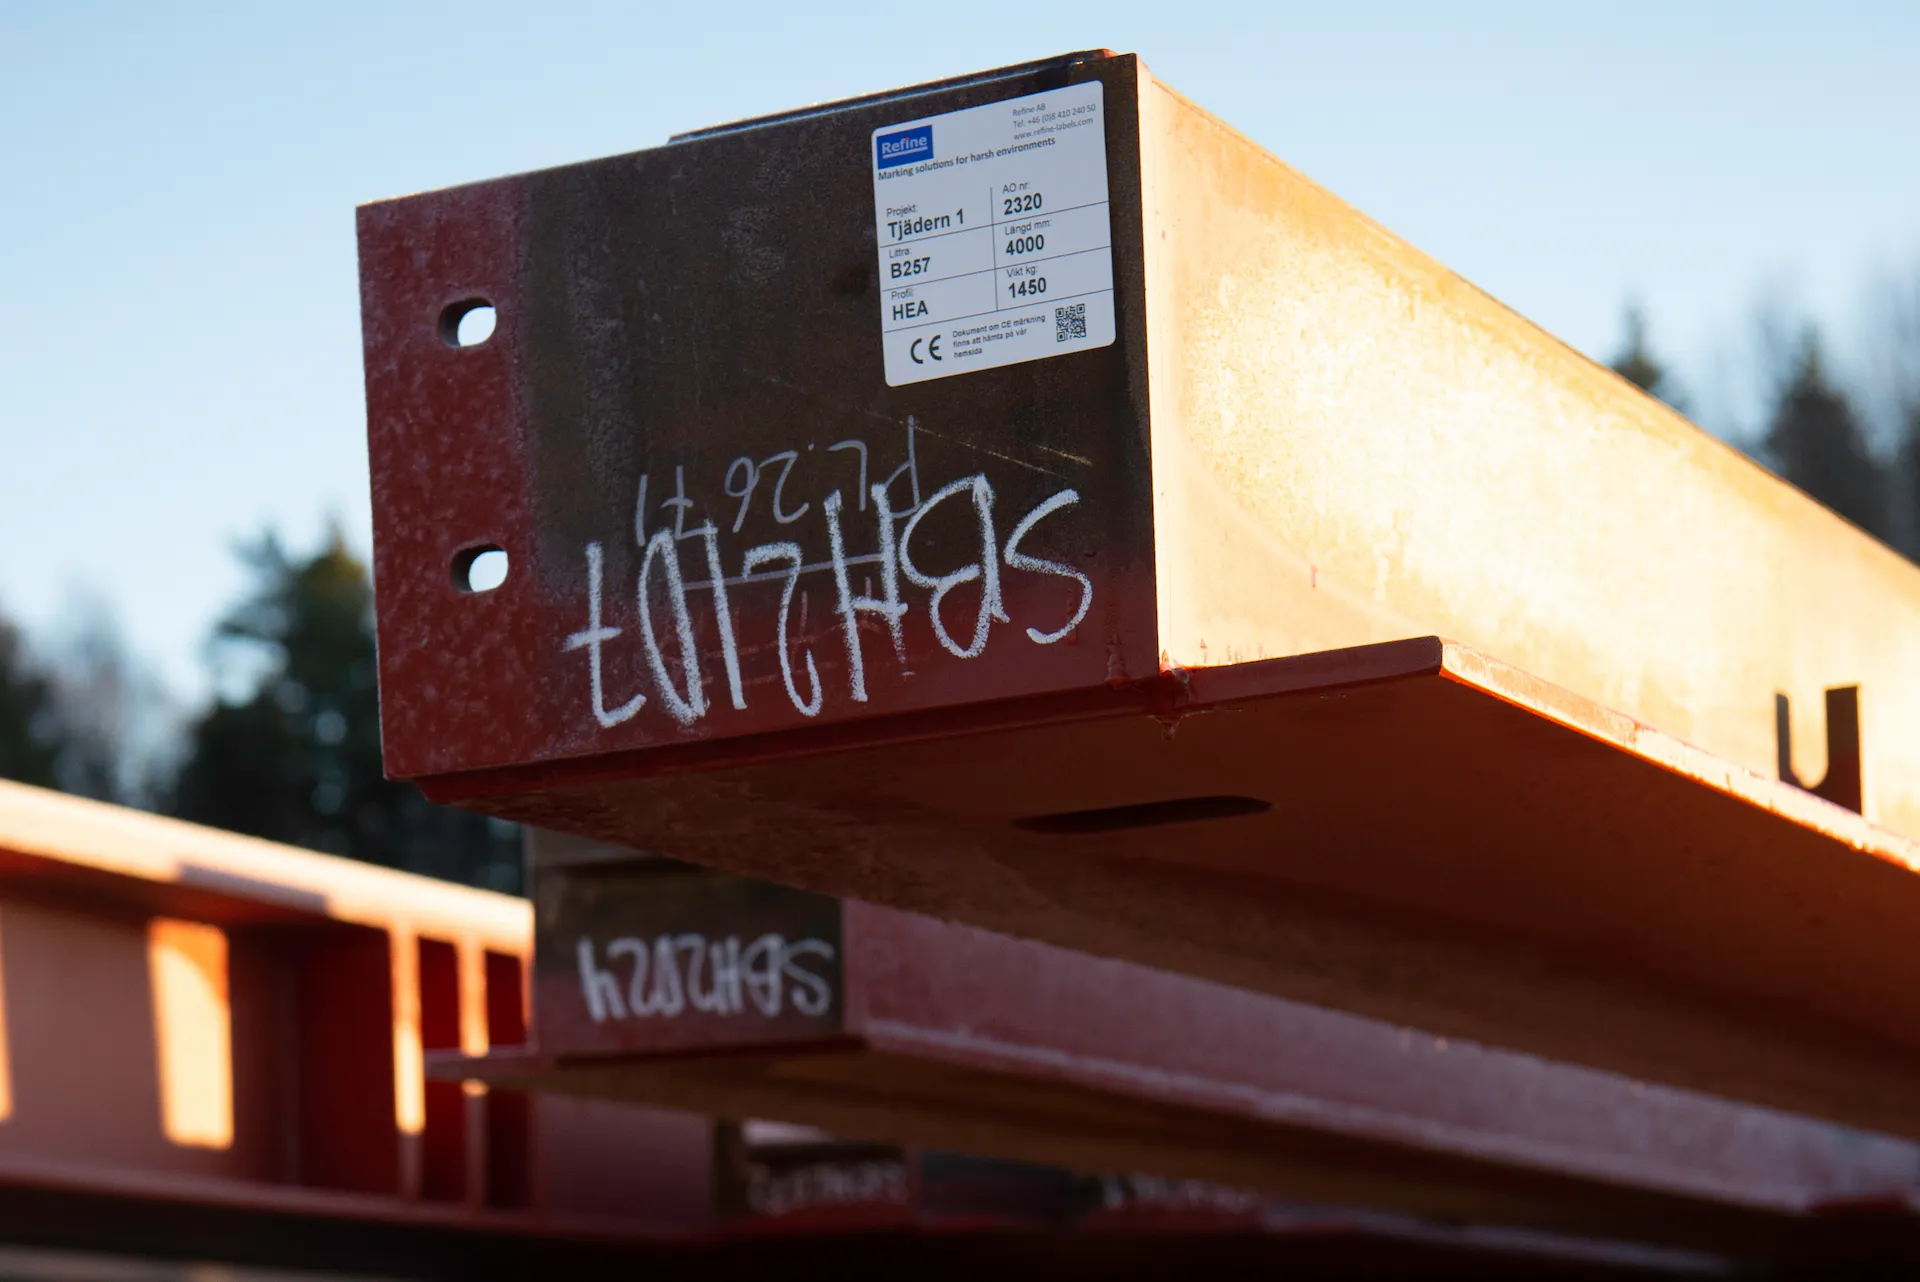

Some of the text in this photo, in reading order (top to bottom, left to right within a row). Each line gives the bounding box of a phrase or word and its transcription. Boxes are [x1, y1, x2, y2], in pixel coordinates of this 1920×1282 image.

[1012, 103, 1046, 117] Refine AB
[1072, 106, 1086, 116] 240
[1087, 103, 1096, 112] 50
[1014, 117, 1094, 140] www.refine-labels.com
[881, 136, 928, 155] Refine
[878, 136, 1056, 181] Marking solutions for harsh environments
[1003, 182, 1017, 195] AO
[886, 203, 918, 218] Projekt:
[1003, 192, 1043, 216] 2320
[887, 208, 965, 240] Tjädern 1
[1004, 220, 1032, 236] Längd
[1005, 234, 1045, 256] 4000
[890, 256, 931, 279] B257
[1006, 264, 1039, 279] Vikt kg:
[891, 288, 915, 301] Profil:
[1008, 276, 1047, 299] 1450
[892, 300, 929, 321] HEA
[953, 325, 987, 338] Dokument
[988, 323, 1000, 331] om
[1001, 320, 1012, 329] CE
[972, 336, 981, 345] att
[954, 347, 983, 359] hemsida
